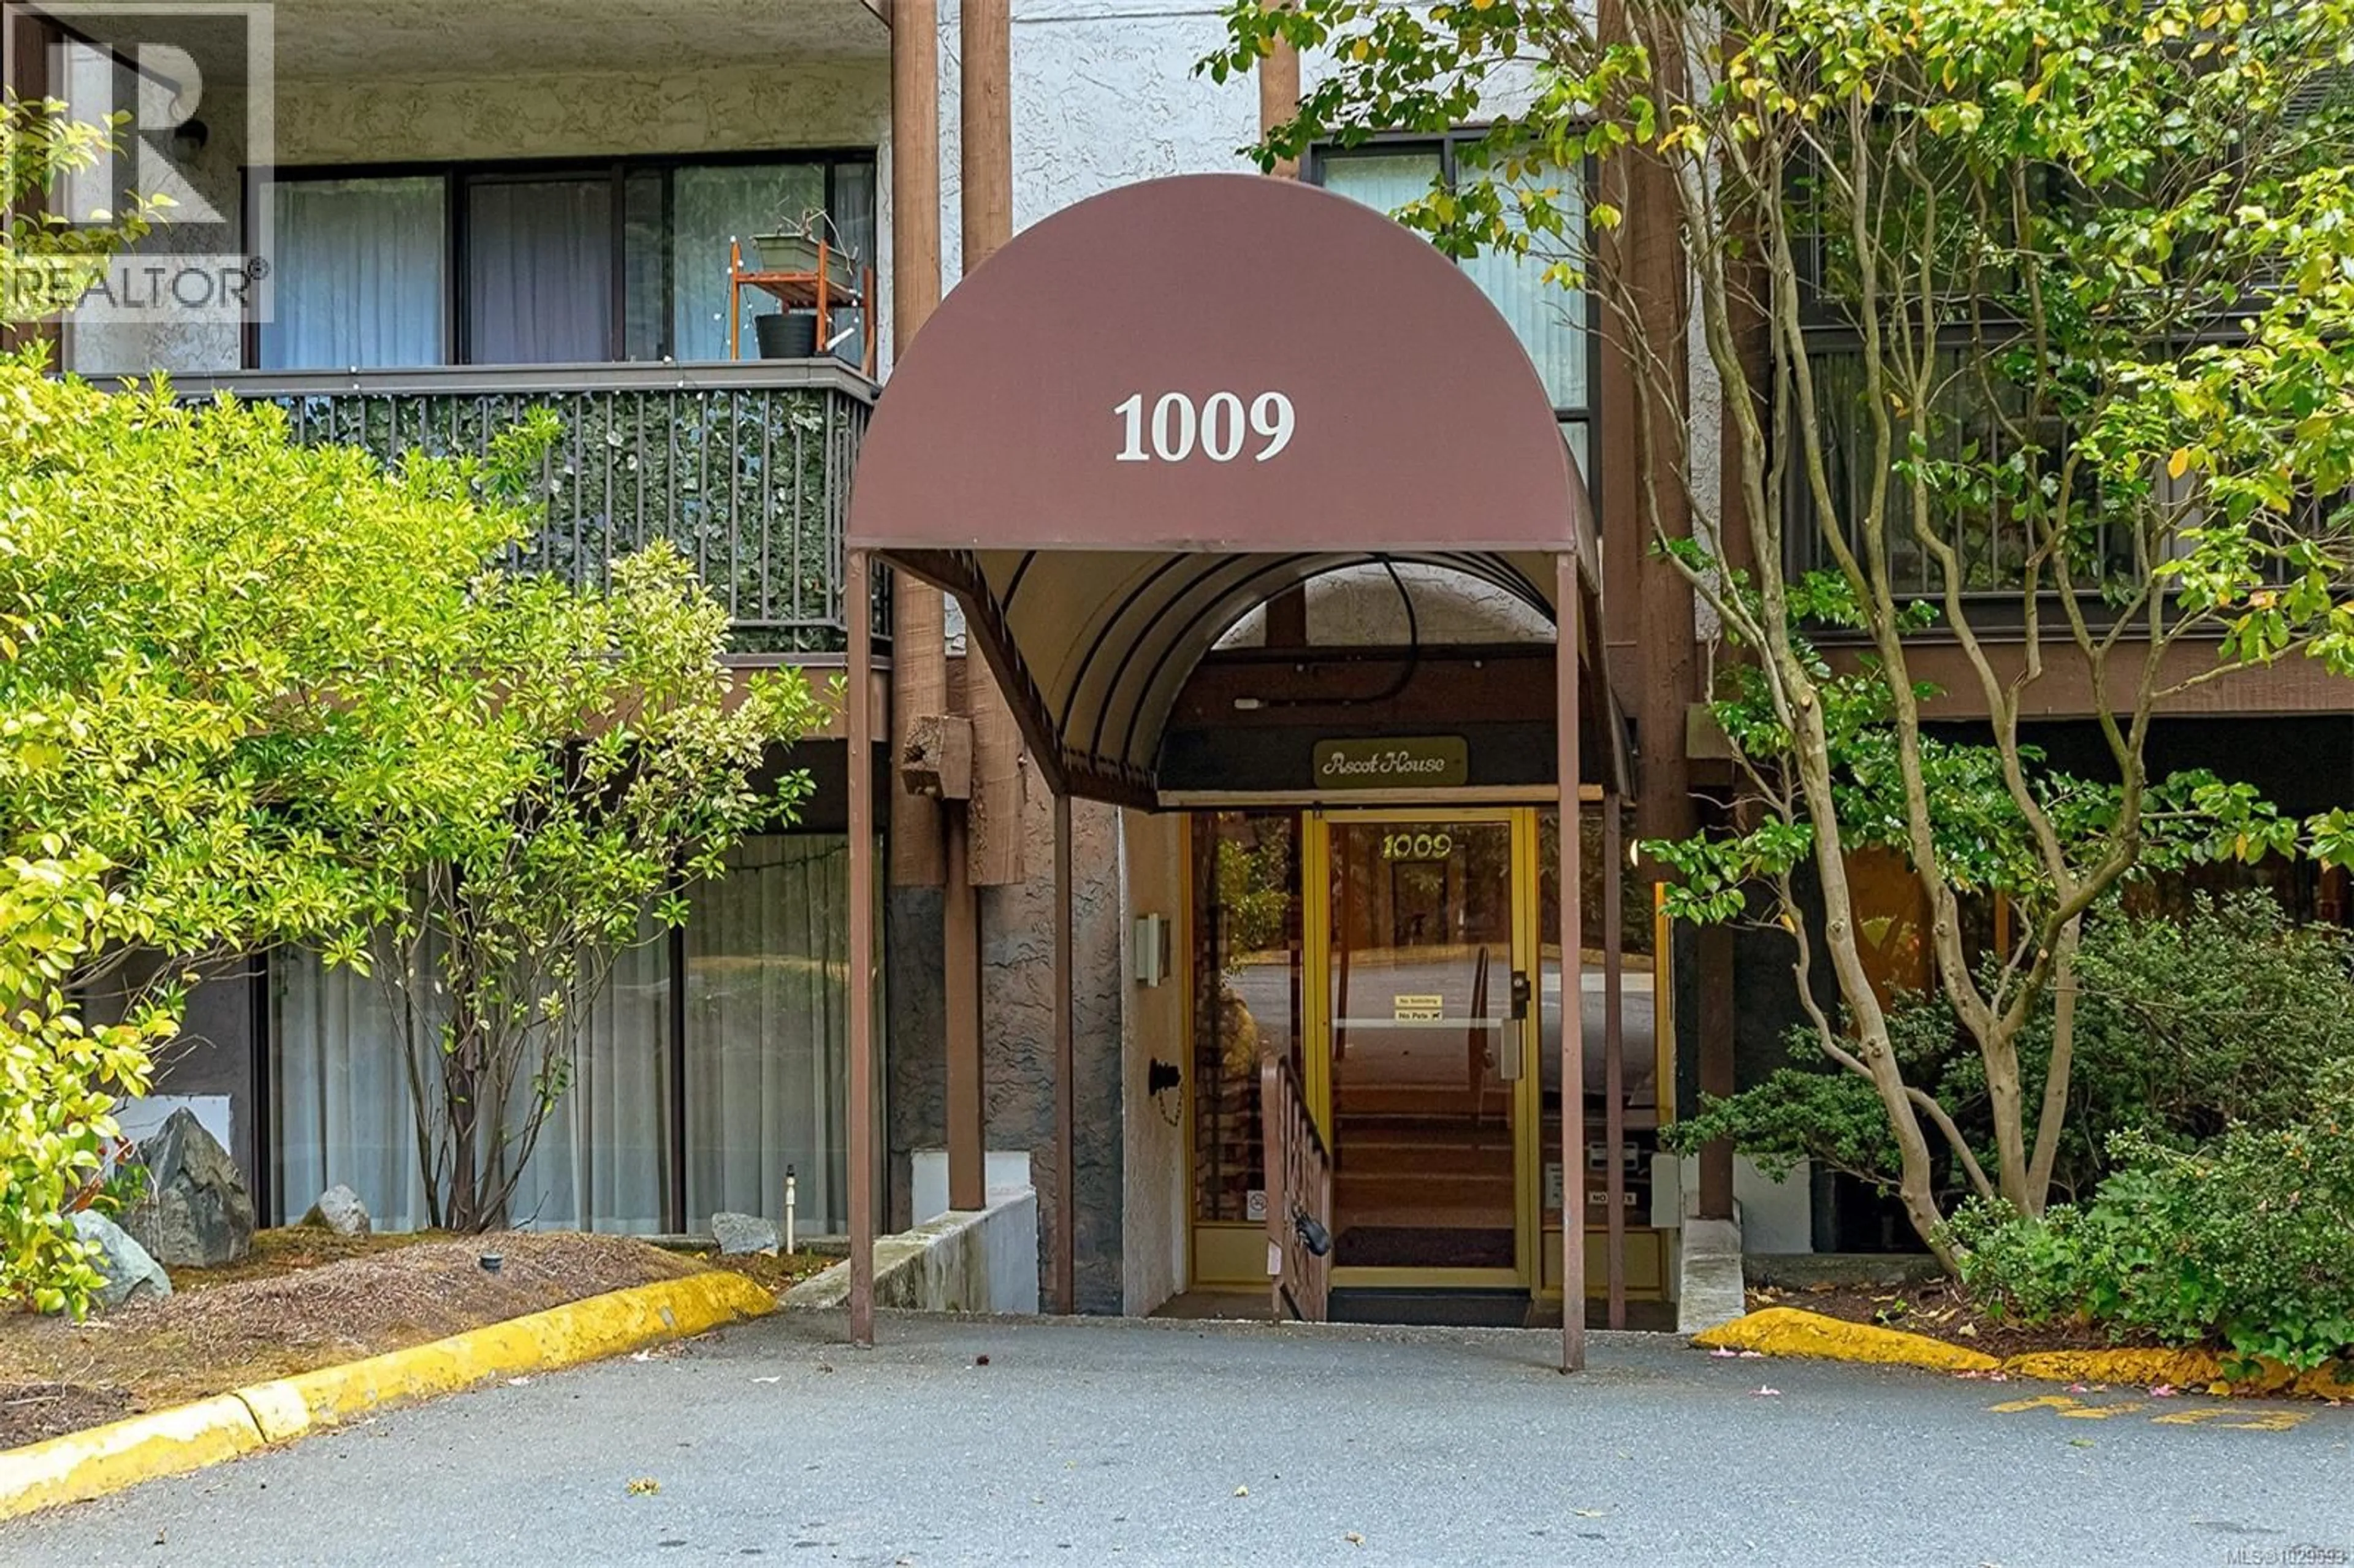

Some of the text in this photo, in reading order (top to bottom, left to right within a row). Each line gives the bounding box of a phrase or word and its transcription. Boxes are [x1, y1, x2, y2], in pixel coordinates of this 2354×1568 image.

[1114, 391, 1295, 462] 1009
[1322, 750, 1445, 775] Ascot House
[1382, 834, 1452, 859] 1009
